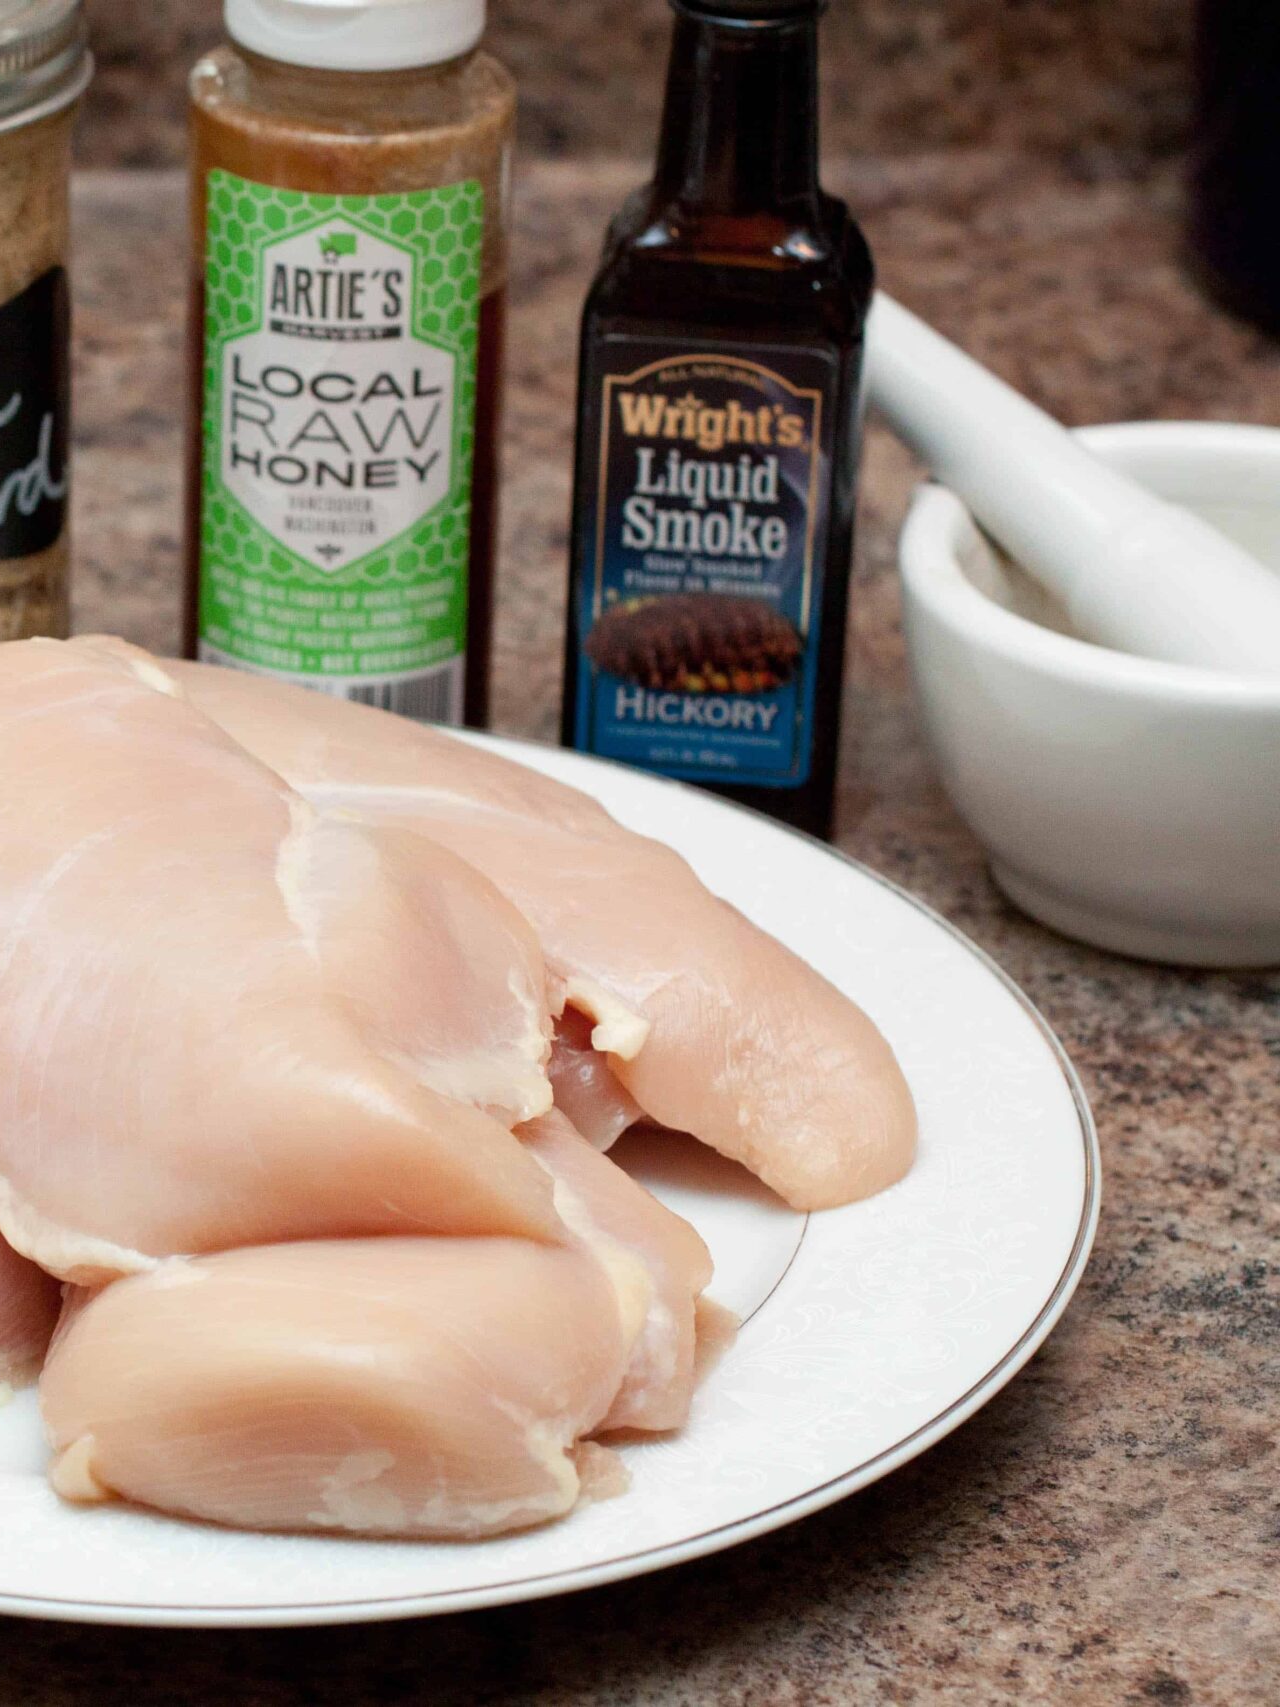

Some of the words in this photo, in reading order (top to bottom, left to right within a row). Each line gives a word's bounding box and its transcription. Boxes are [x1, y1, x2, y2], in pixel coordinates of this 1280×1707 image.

[232, 353, 442, 403] LOCAL
[231, 391, 442, 454] RAW
[619, 391, 806, 451] Wright's
[231, 441, 441, 490] HONEY
[635, 447, 778, 509] Liquid
[622, 495, 788, 559] Smoke
